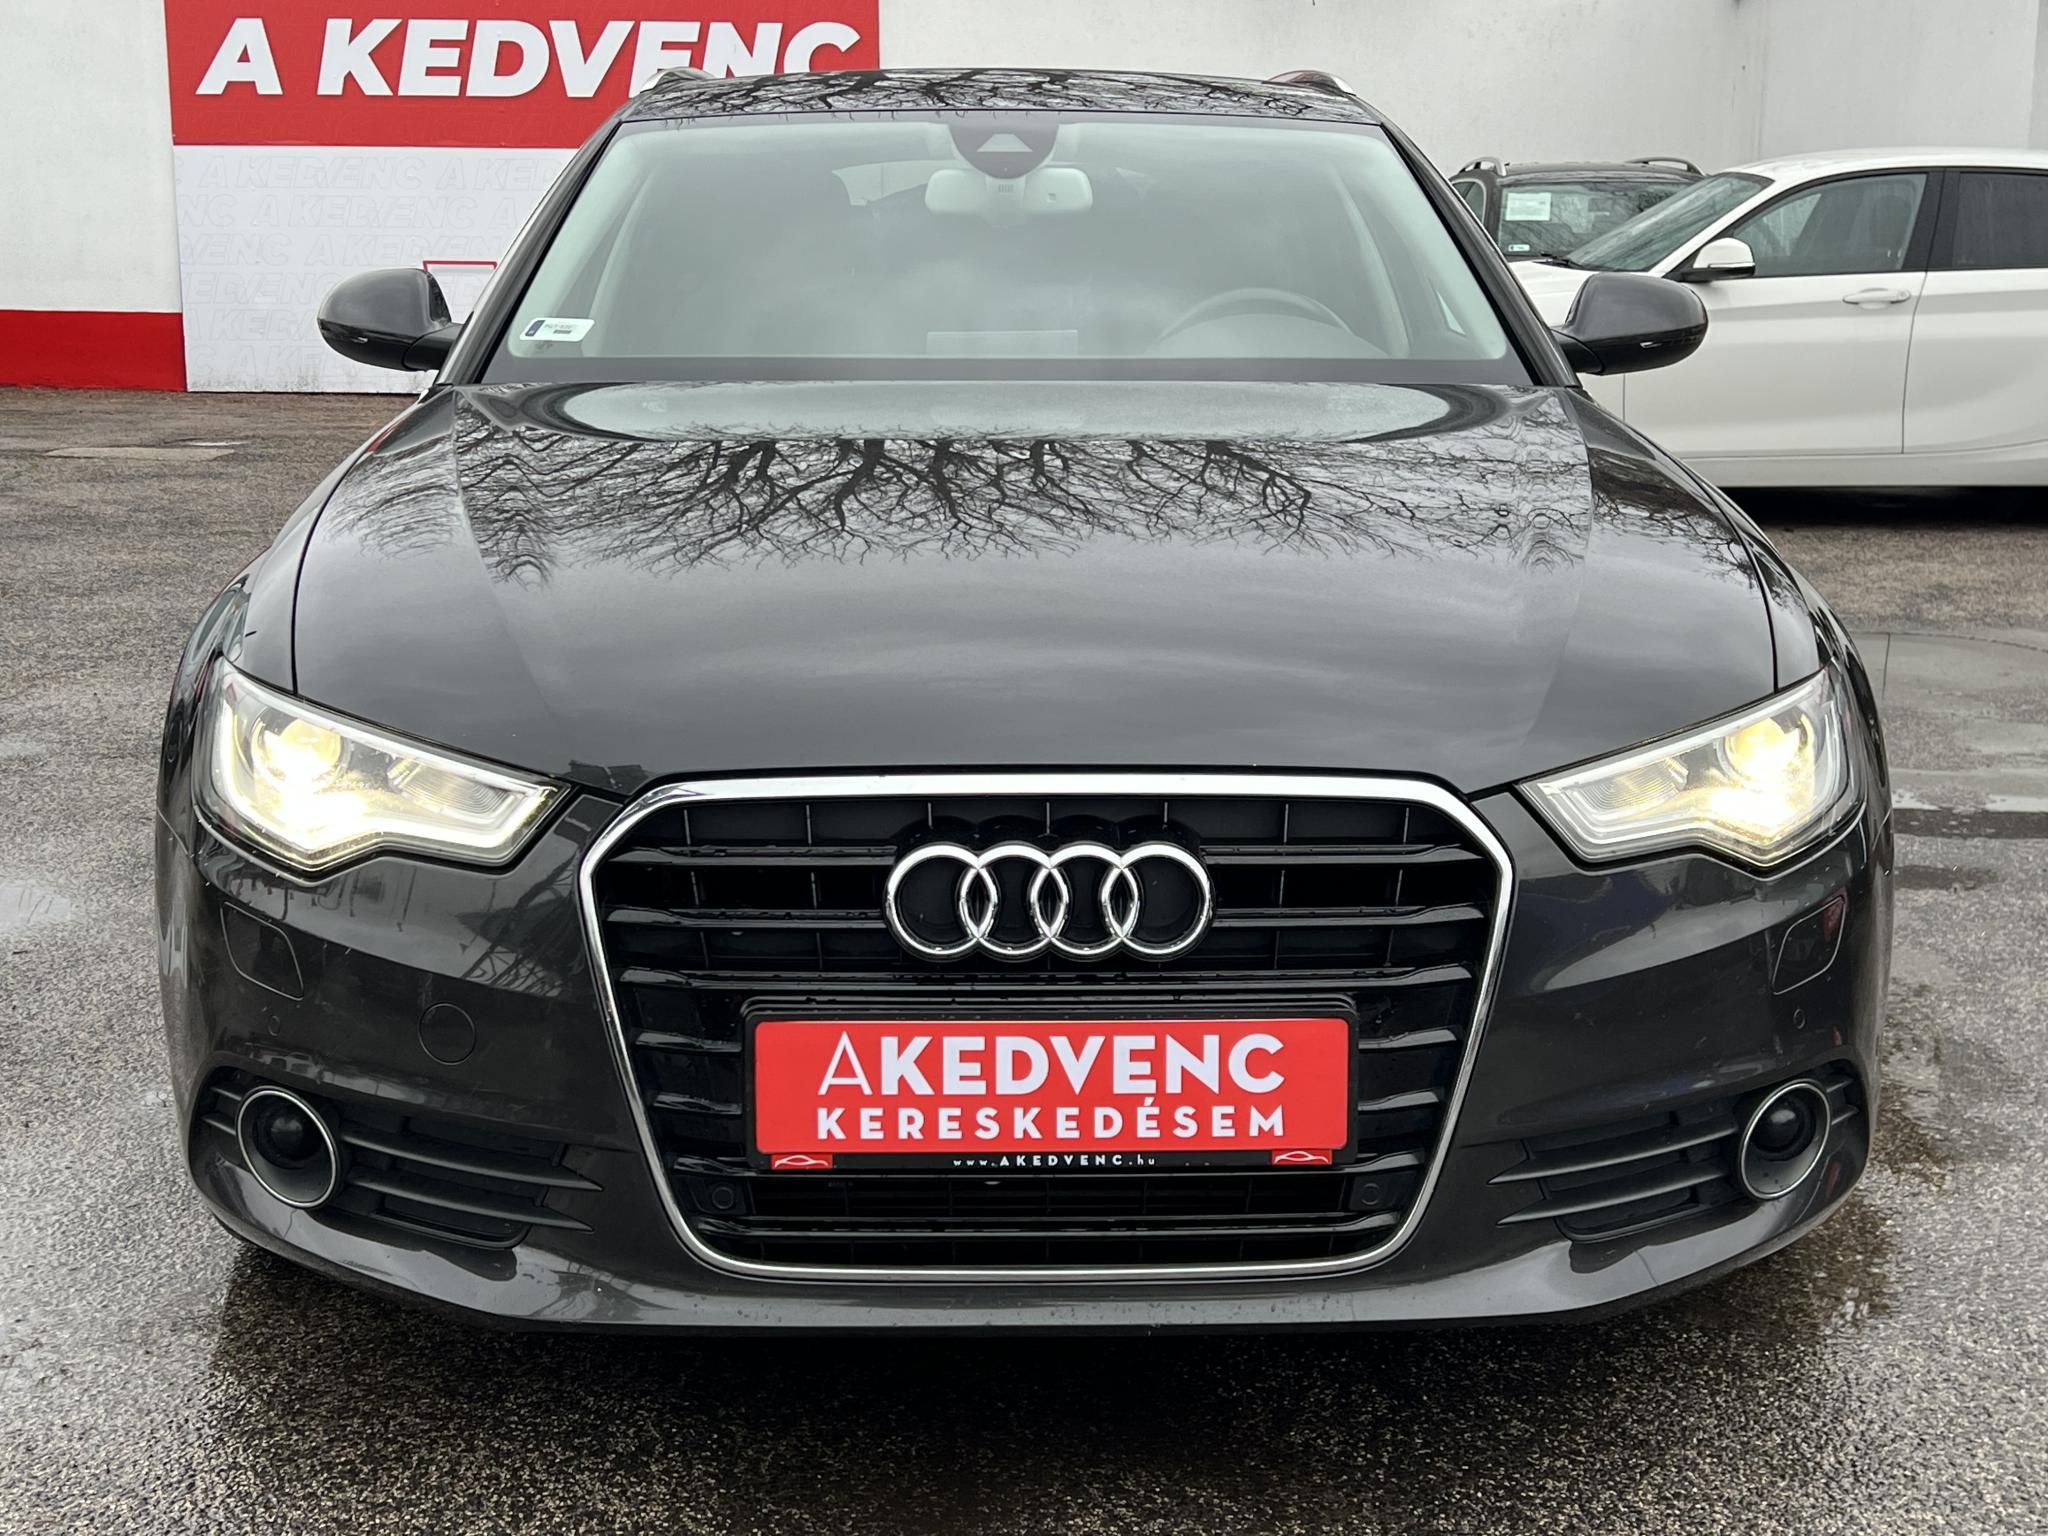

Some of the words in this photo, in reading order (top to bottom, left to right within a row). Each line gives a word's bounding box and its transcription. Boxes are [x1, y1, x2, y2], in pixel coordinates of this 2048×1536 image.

[195, 17, 283, 95] A
[316, 18, 861, 98] KEDVENC
[816, 1097, 1284, 1140] KERESKEDÉSEM
